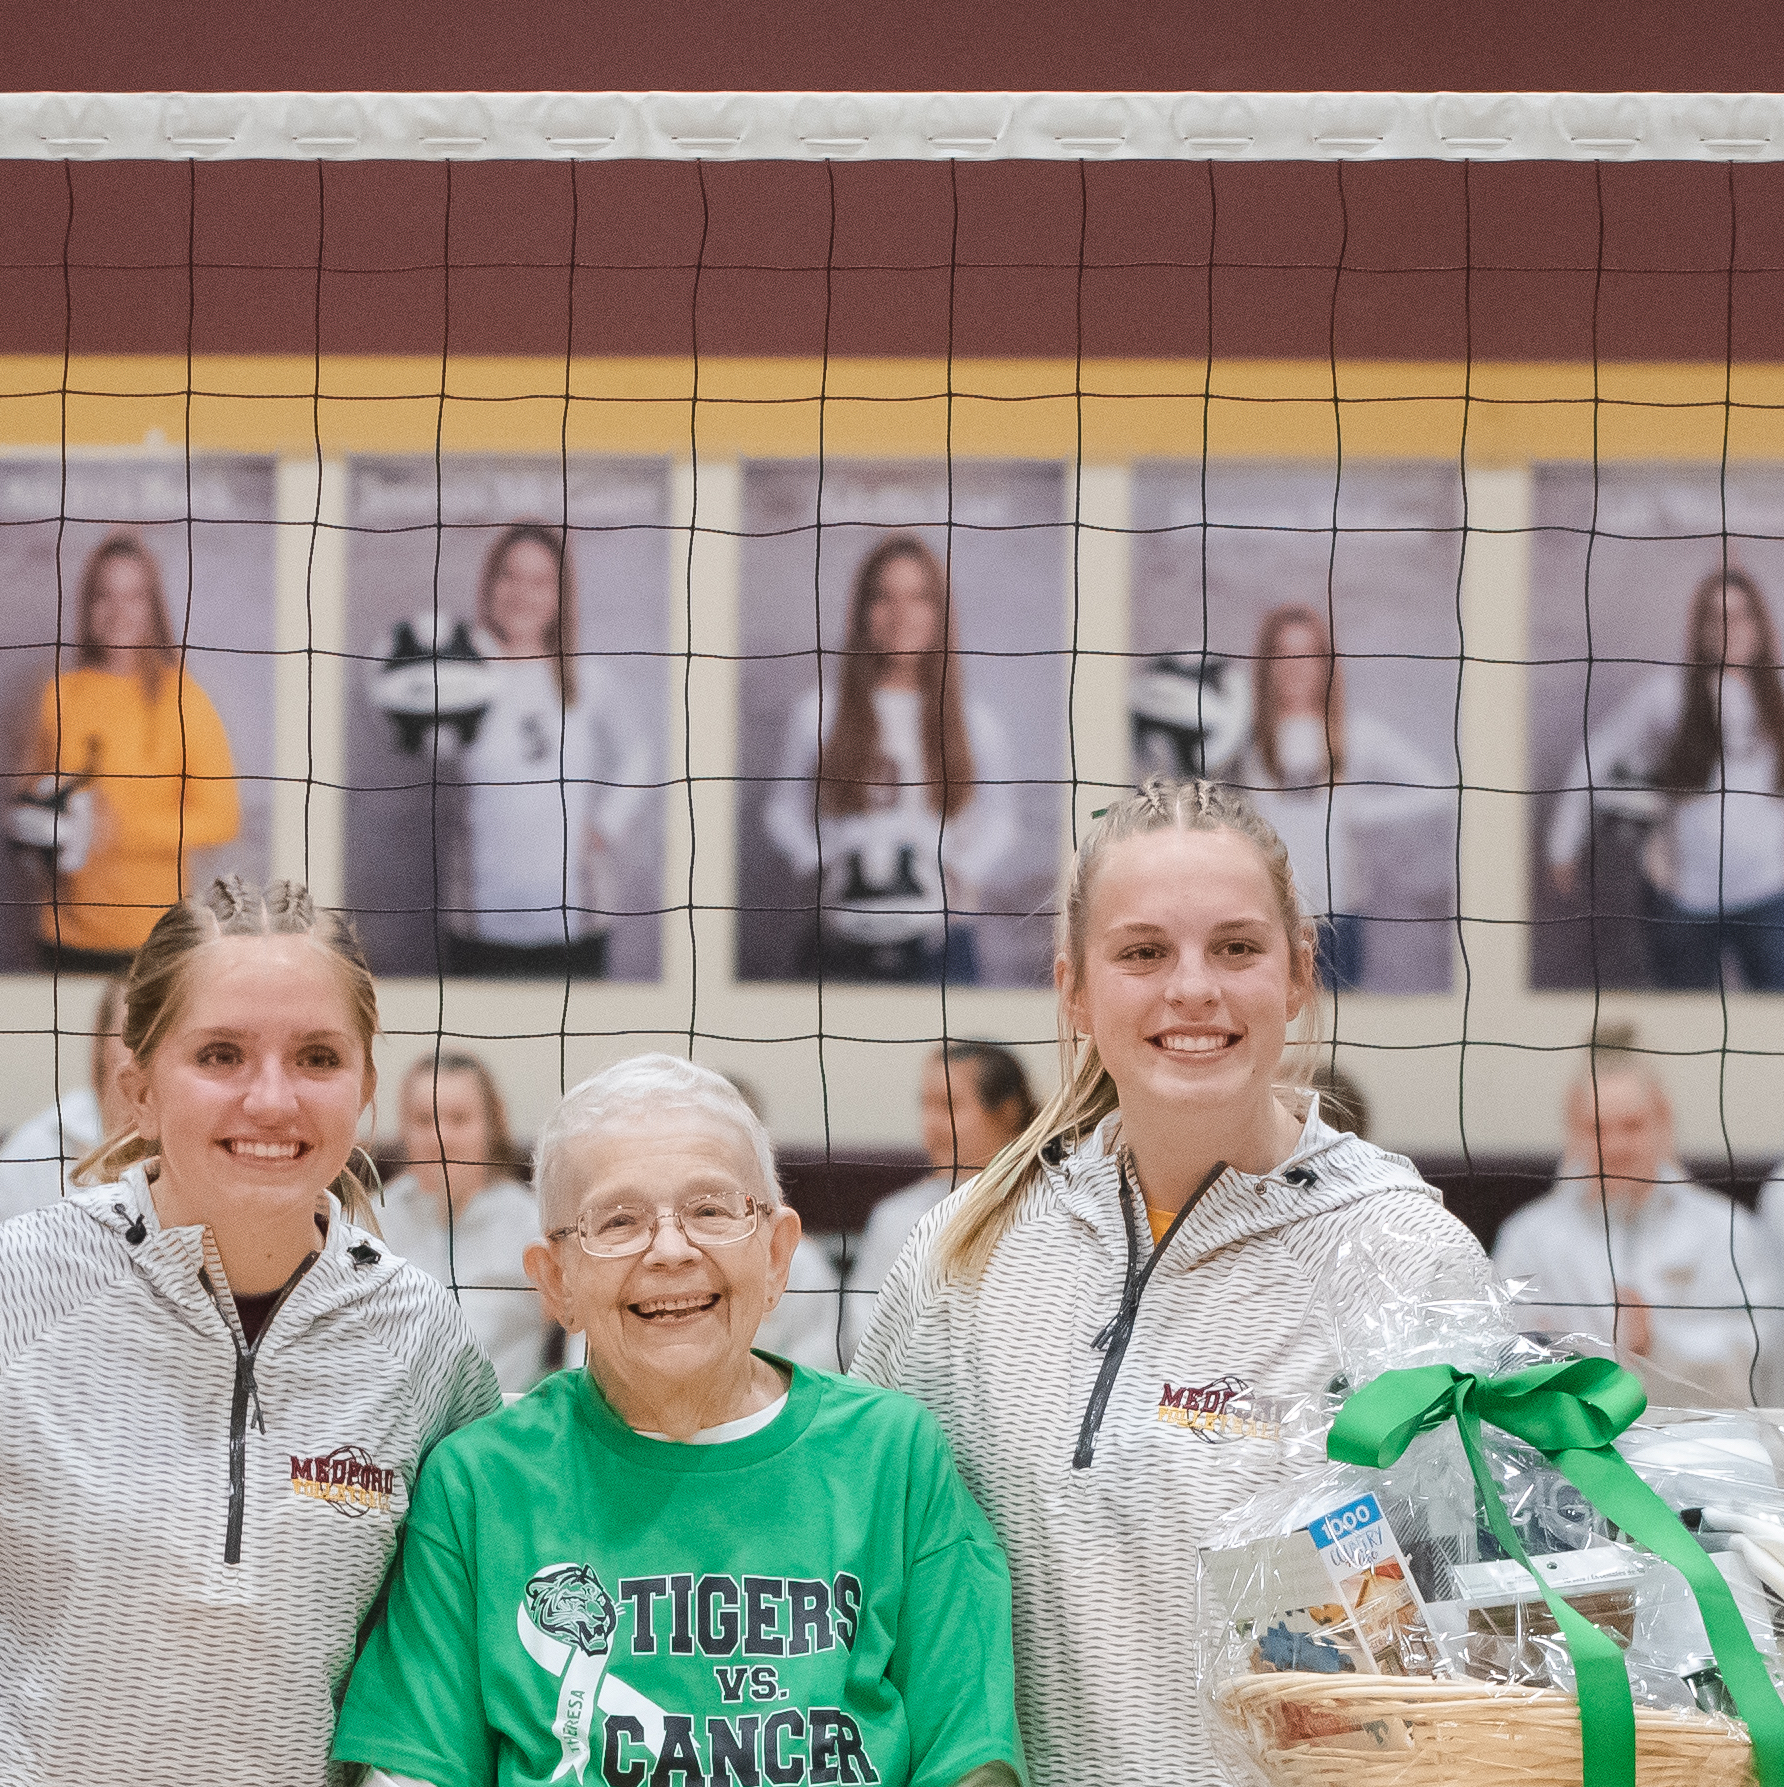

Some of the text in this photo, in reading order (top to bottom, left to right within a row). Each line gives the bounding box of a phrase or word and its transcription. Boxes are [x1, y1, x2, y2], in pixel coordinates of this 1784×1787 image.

[290, 1455, 395, 1494] MEDFORD
[1322, 1504, 1370, 1540] 1000
[618, 1571, 863, 1659] TIGERS
[563, 1690, 585, 1753] THERESA
